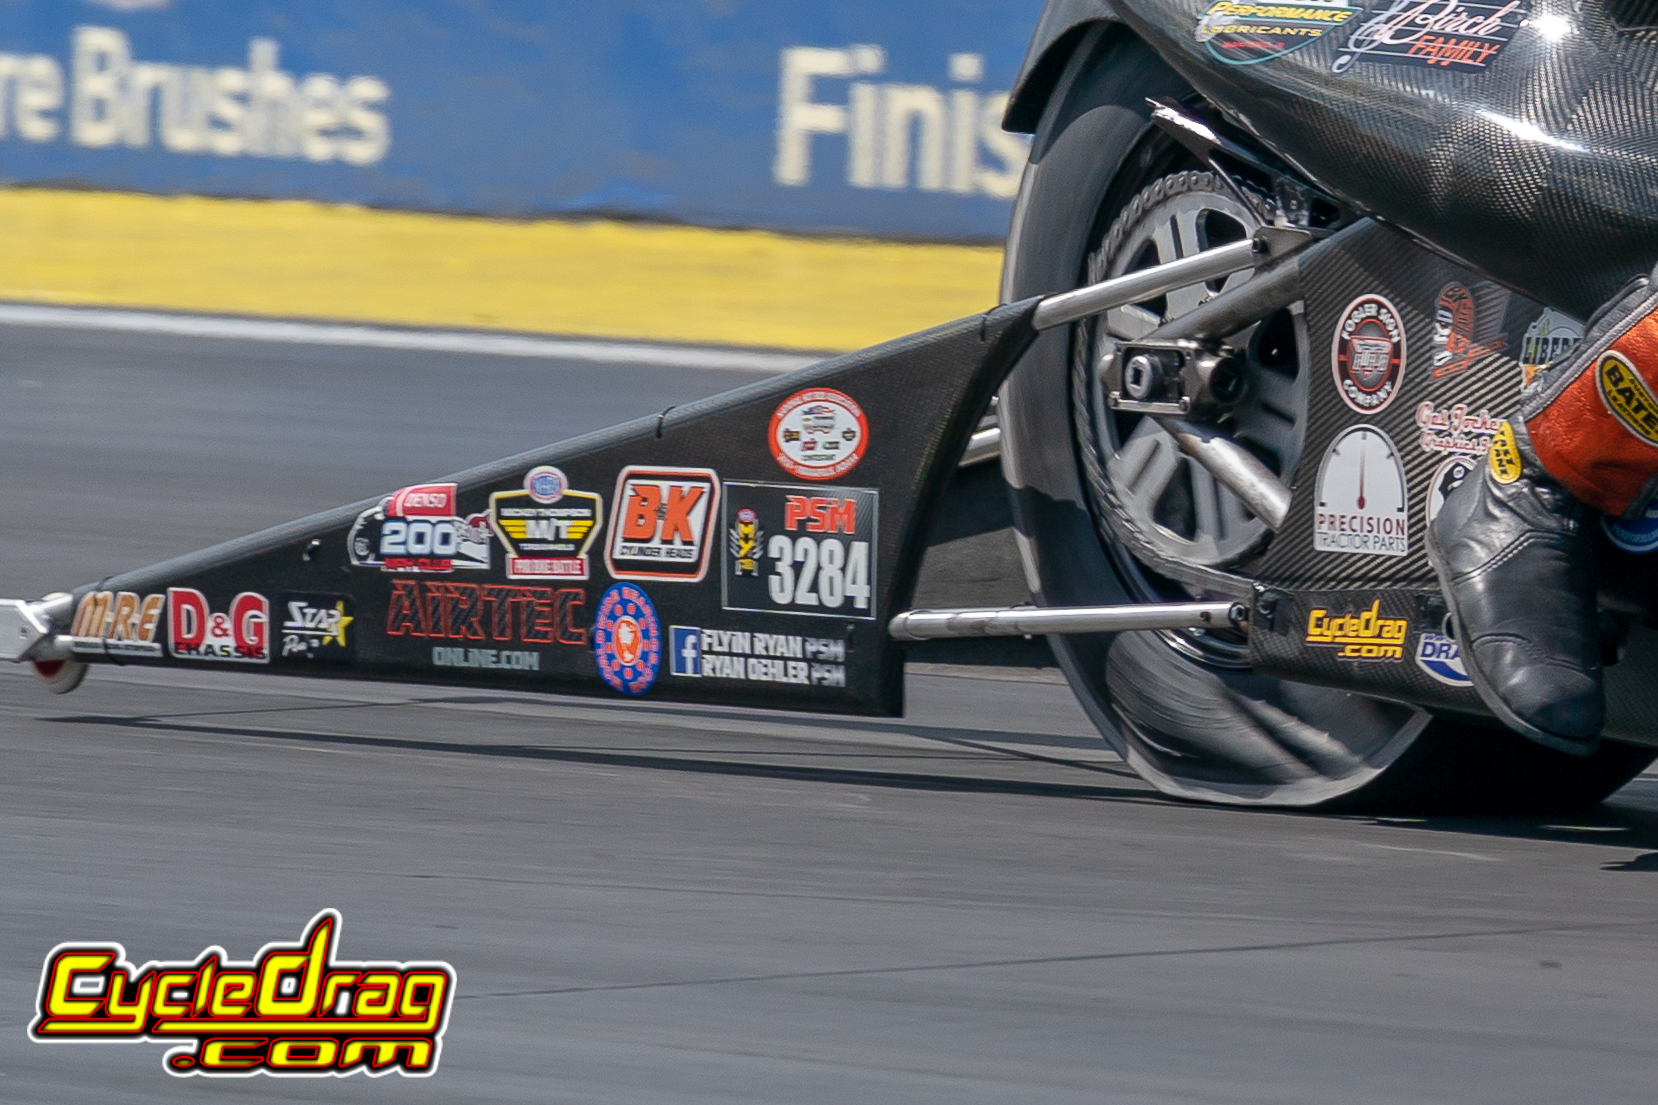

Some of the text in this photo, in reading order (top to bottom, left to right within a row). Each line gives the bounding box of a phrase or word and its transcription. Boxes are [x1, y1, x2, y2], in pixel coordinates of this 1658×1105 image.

[1206, 1, 1353, 23] PERFORMANCE
[1202, 24, 1323, 37] LUBRICANTS
[1407, 35, 1501, 67] FAMILY
[72, 26, 390, 166] Brushes
[774, 47, 1026, 192] Finis
[405, 494, 447, 508] DENSO
[784, 495, 856, 534] PSM
[380, 521, 457, 555] 200
[1317, 513, 1405, 536] PRECISION
[1317, 531, 1406, 552] TRACTOR PARTS
[767, 534, 870, 609] 3284
[168, 588, 269, 646] D&G
[386, 579, 588, 644] AIRTEC
[1307, 598, 1408, 644] CycleDrag
[173, 643, 266, 660] CHASSIS
[432, 646, 540, 671] ONLINE.COM
[702, 629, 749, 652] FLYIN
[752, 632, 803, 657] RYAN
[805, 637, 846, 661] PSM
[1337, 645, 1403, 658] .com
[702, 654, 846, 687] RYAN OEHLER PSM
